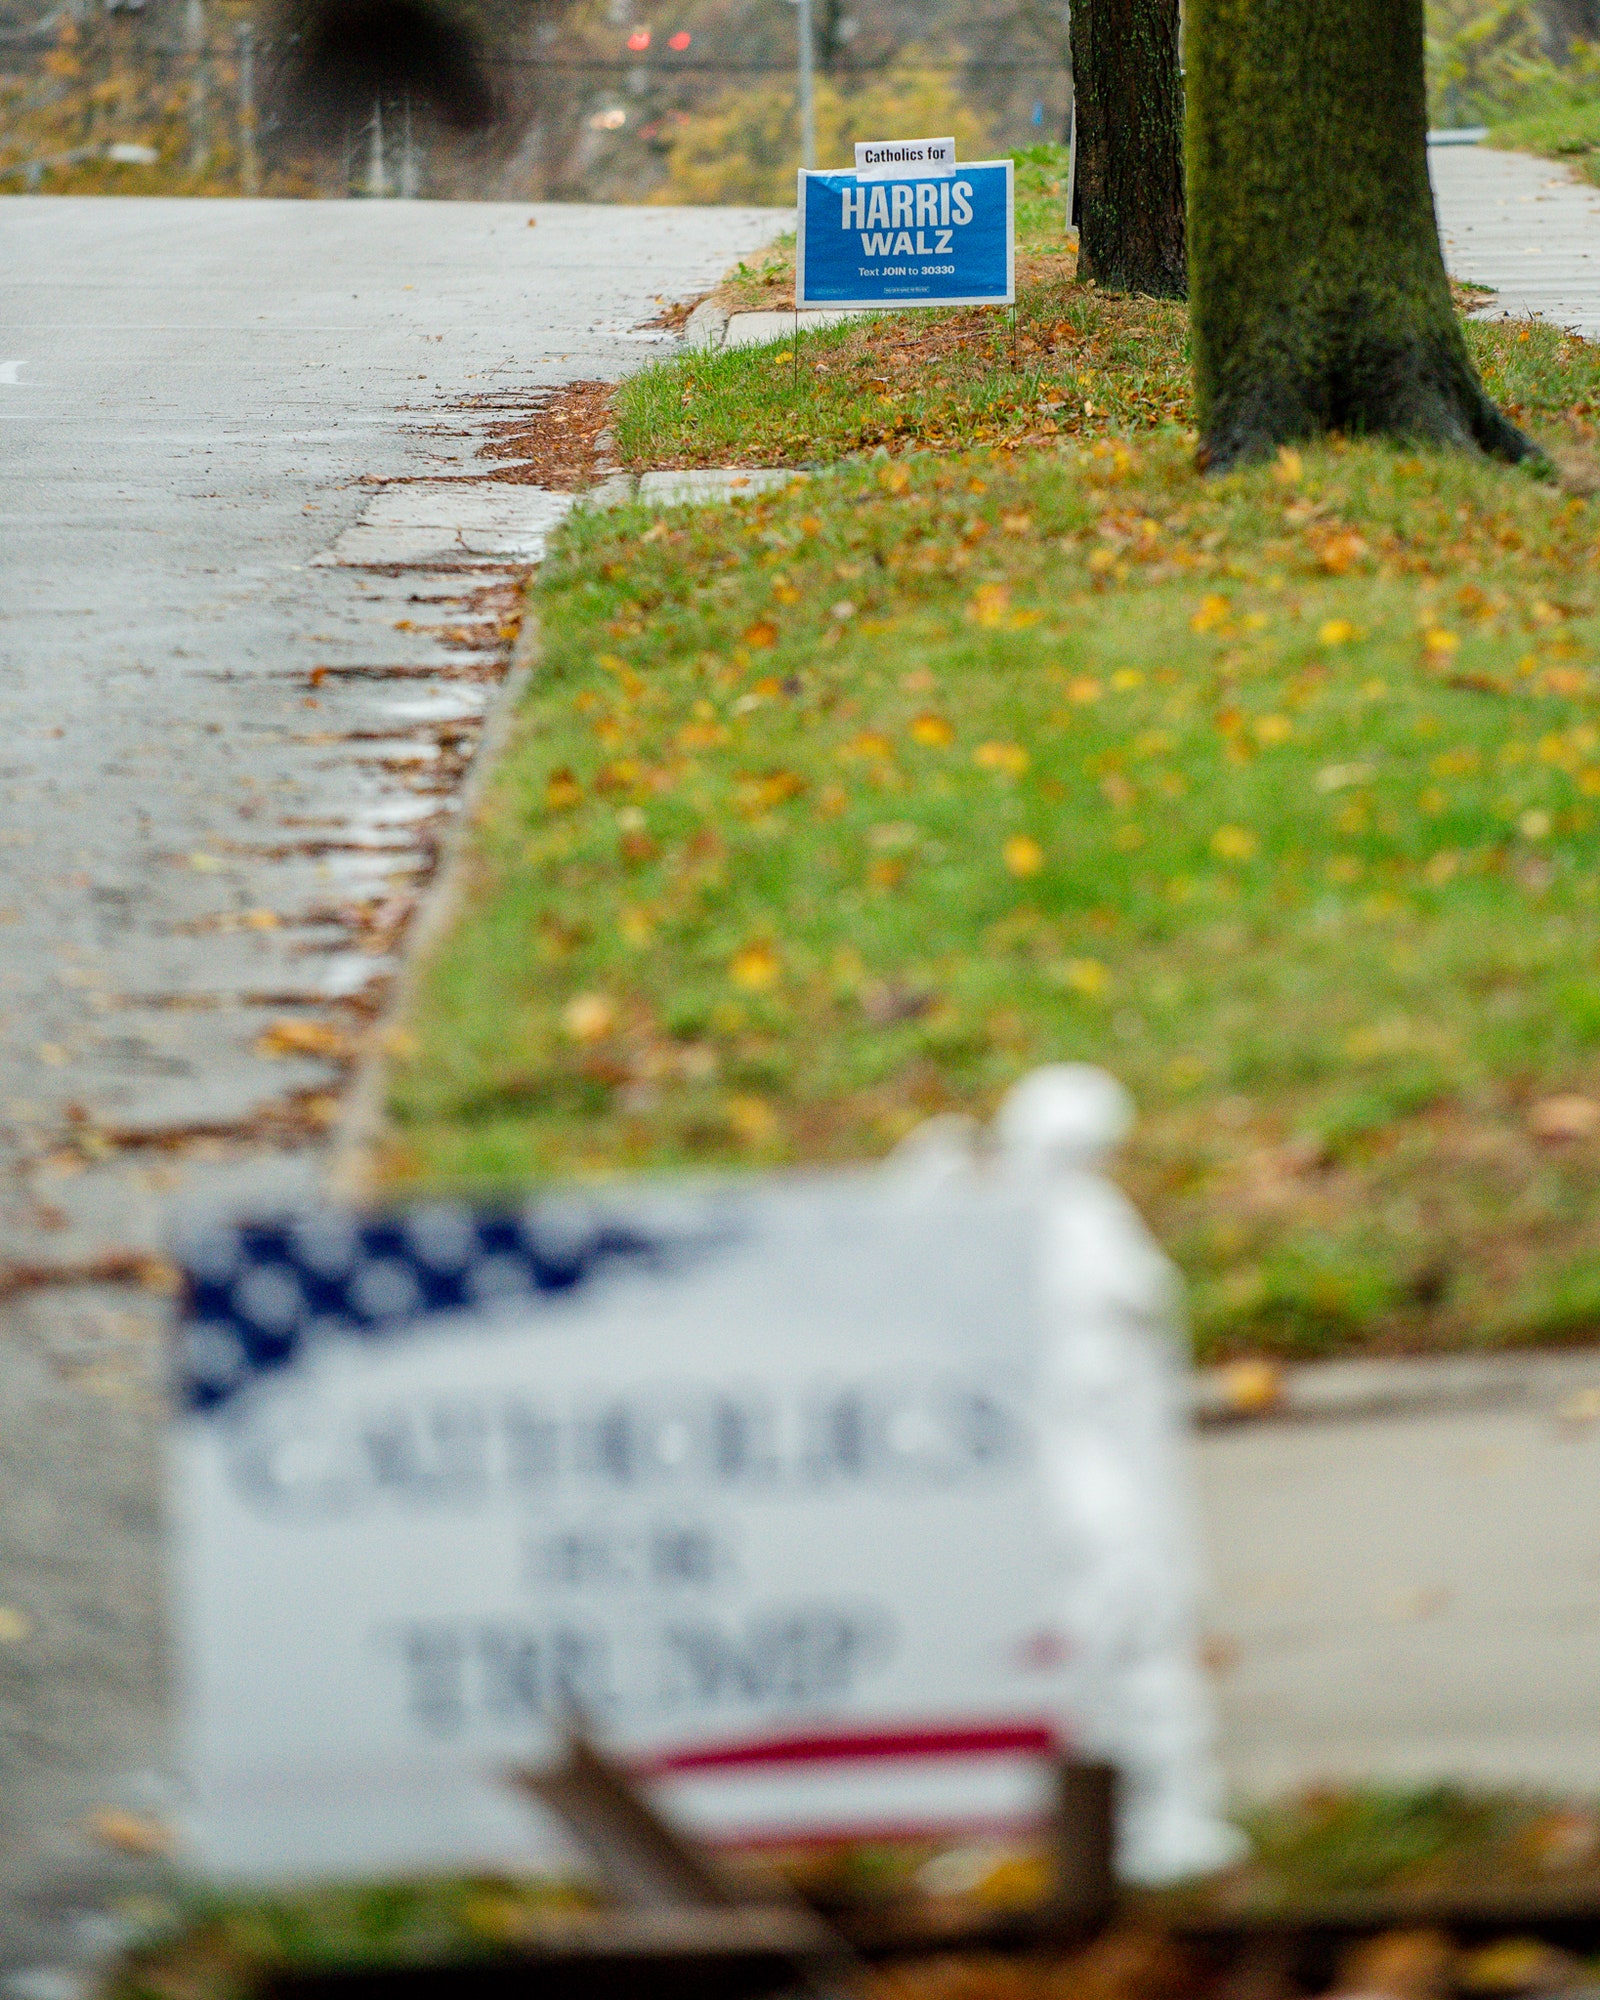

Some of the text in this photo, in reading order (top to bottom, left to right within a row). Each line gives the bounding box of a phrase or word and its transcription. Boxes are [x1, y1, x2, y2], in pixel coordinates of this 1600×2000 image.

[865, 146, 946, 163] Catholics for
[841, 181, 974, 230] HARRIS
[860, 229, 954, 257] WALZ
[858, 265, 955, 277] Text JOIN to 30330
